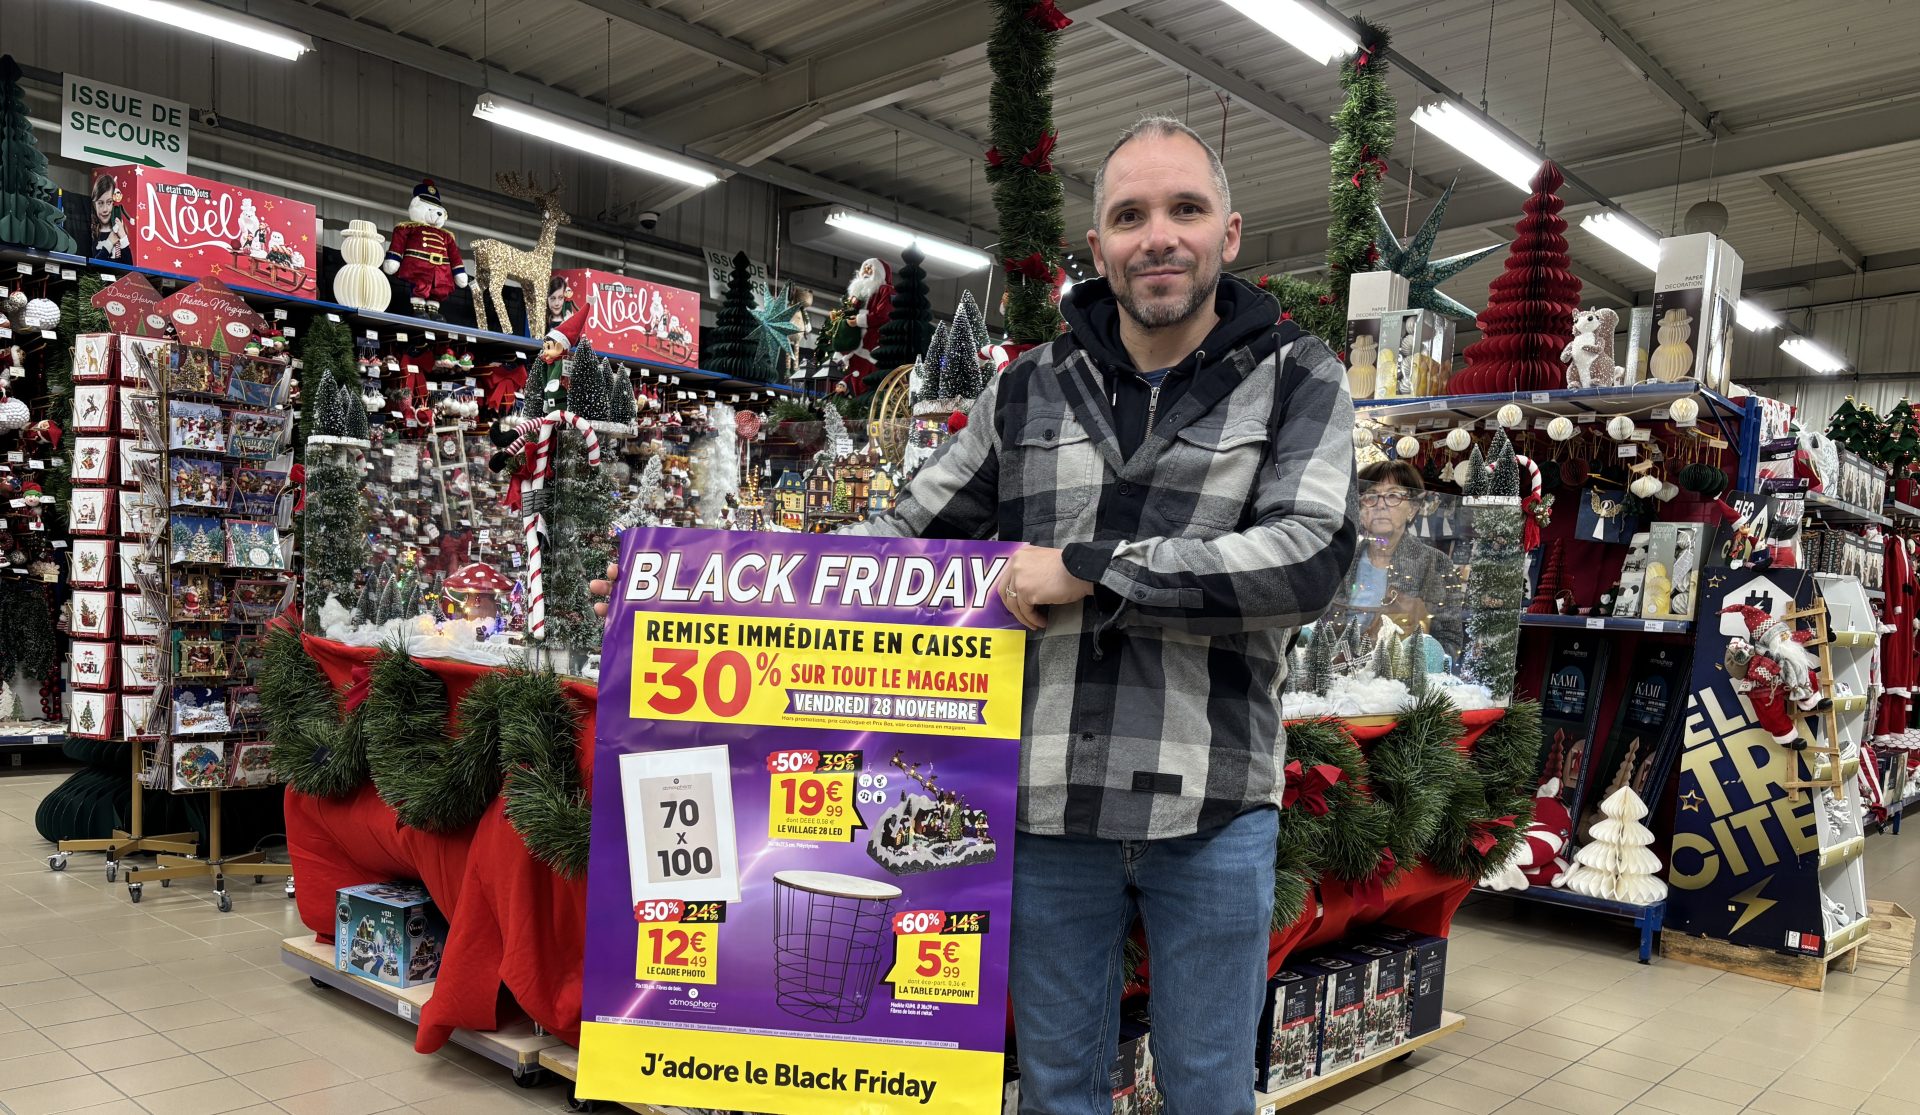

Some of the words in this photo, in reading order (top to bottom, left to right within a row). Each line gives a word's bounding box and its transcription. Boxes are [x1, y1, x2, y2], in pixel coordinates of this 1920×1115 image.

[71, 83, 142, 118] ISSUE
[152, 103, 182, 128] DE
[70, 111, 181, 153] SECOURS
[141, 183, 242, 248] Noël
[712, 267, 765, 296] SERS
[749, 264, 765, 279] DE
[1664, 281, 1703, 290] DECORATION
[210, 298, 252, 317] Magique
[588, 282, 653, 334] Noël
[625, 552, 807, 605] BLACK
[809, 555, 1009, 609] FRIDAY
[647, 620, 729, 645] REMISE
[738, 623, 864, 652] IMMÉDIATE
[873, 631, 902, 654] EN
[912, 633, 992, 658] CAISSE
[644, 647, 781, 718] -30%
[791, 663, 826, 684] SUR
[832, 666, 877, 687] TOUT
[882, 668, 901, 688] LE
[907, 670, 989, 693] MAGASIN
[1550, 673, 1578, 688] KAMI
[1635, 682, 1661, 698] KAMI
[795, 693, 869, 714] VENDREDI
[873, 698, 891, 716] 28
[895, 701, 977, 720] NOVEMBRE
[772, 752, 813, 771] -50%
[660, 799, 699, 828] 70
[778, 825, 786, 833] LE
[787, 826, 817, 834] VILLAGE
[819, 827, 828, 835] 28
[1669, 790, 1819, 890] CITE
[657, 846, 713, 877] 100
[640, 902, 679, 921] -50%
[897, 913, 940, 933] -60%
[647, 966, 655, 975] LE
[656, 967, 680, 976] CADRE
[681, 968, 706, 978] PHOTO
[669, 998, 717, 1009] atmosphera
[899, 986, 908, 994] LA
[910, 986, 933, 995] TABLE
[934, 988, 974, 998] D'APPOINT
[641, 1053, 738, 1082] J'adore
[745, 1061, 768, 1085] le
[774, 1063, 847, 1091] Black
[854, 1069, 937, 1105] Friday
